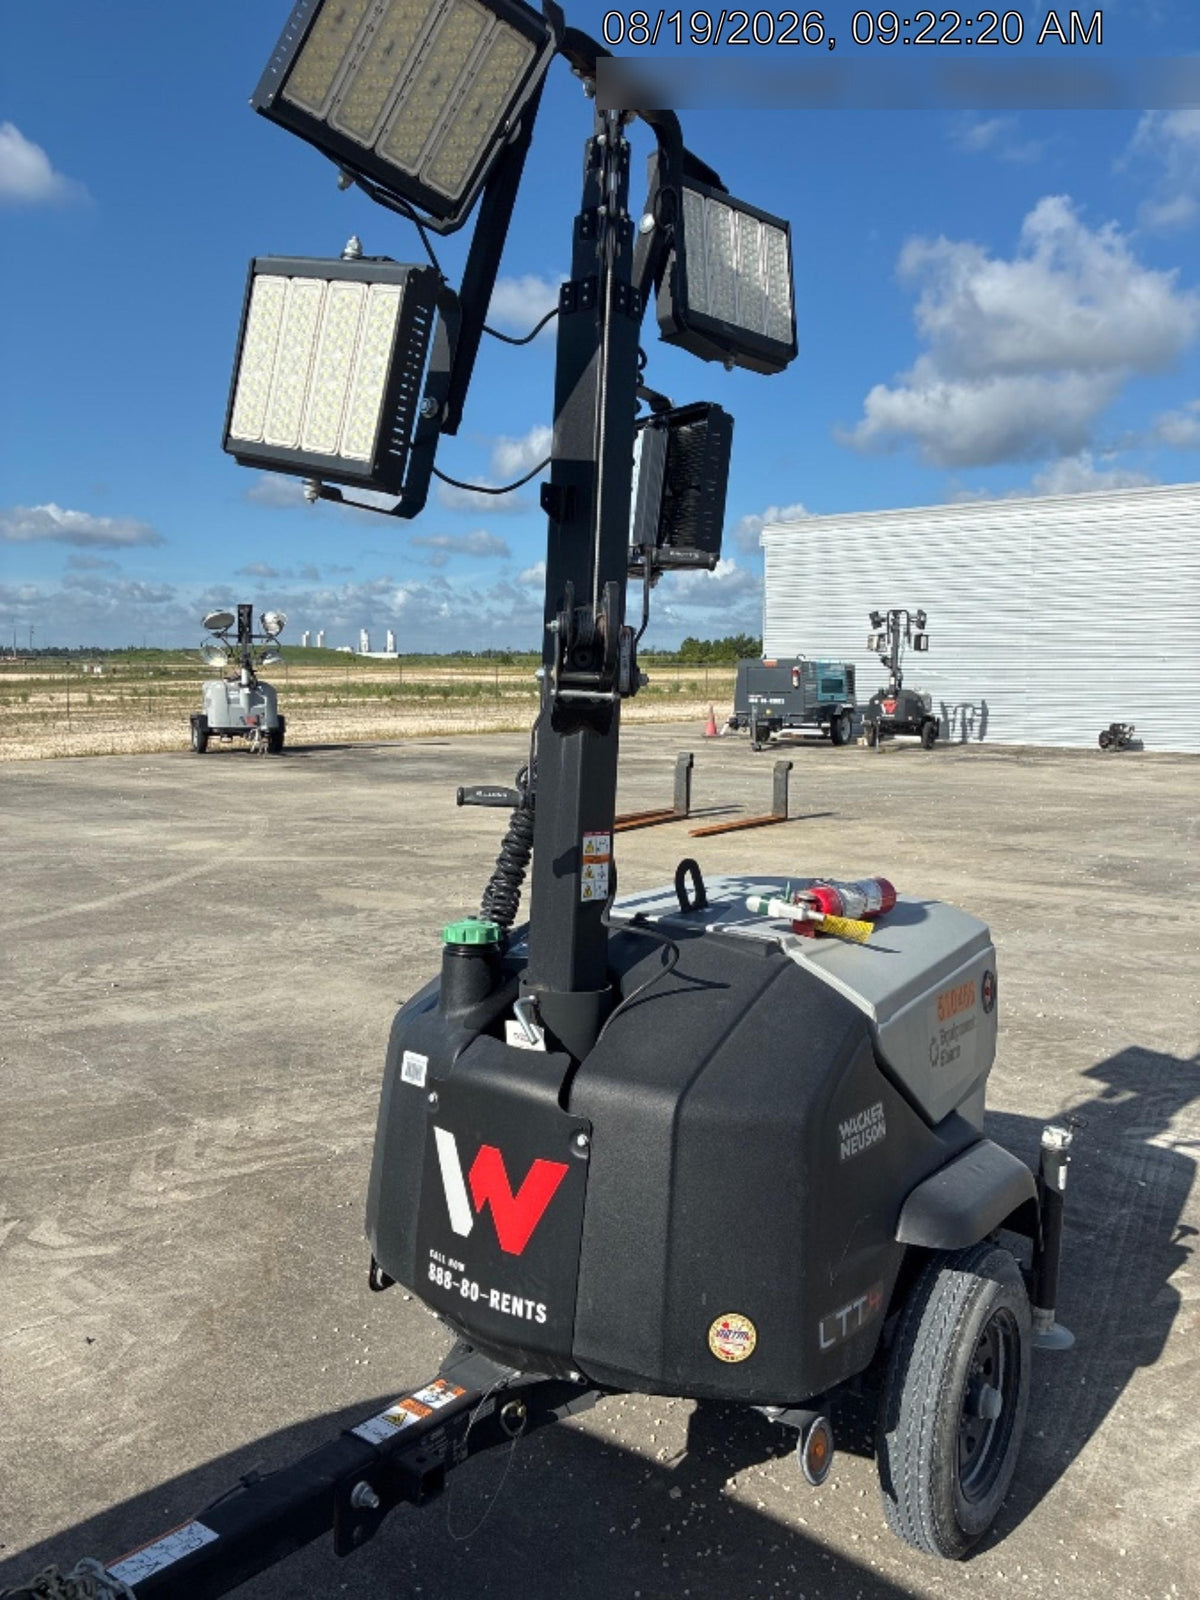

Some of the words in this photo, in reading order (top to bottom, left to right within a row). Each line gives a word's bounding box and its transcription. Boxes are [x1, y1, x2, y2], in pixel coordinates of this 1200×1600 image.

[838, 1102, 885, 1140] WACKER
[840, 1121, 887, 1160] NEUSON
[428, 1262, 547, 1324] 888-80-RENTS
